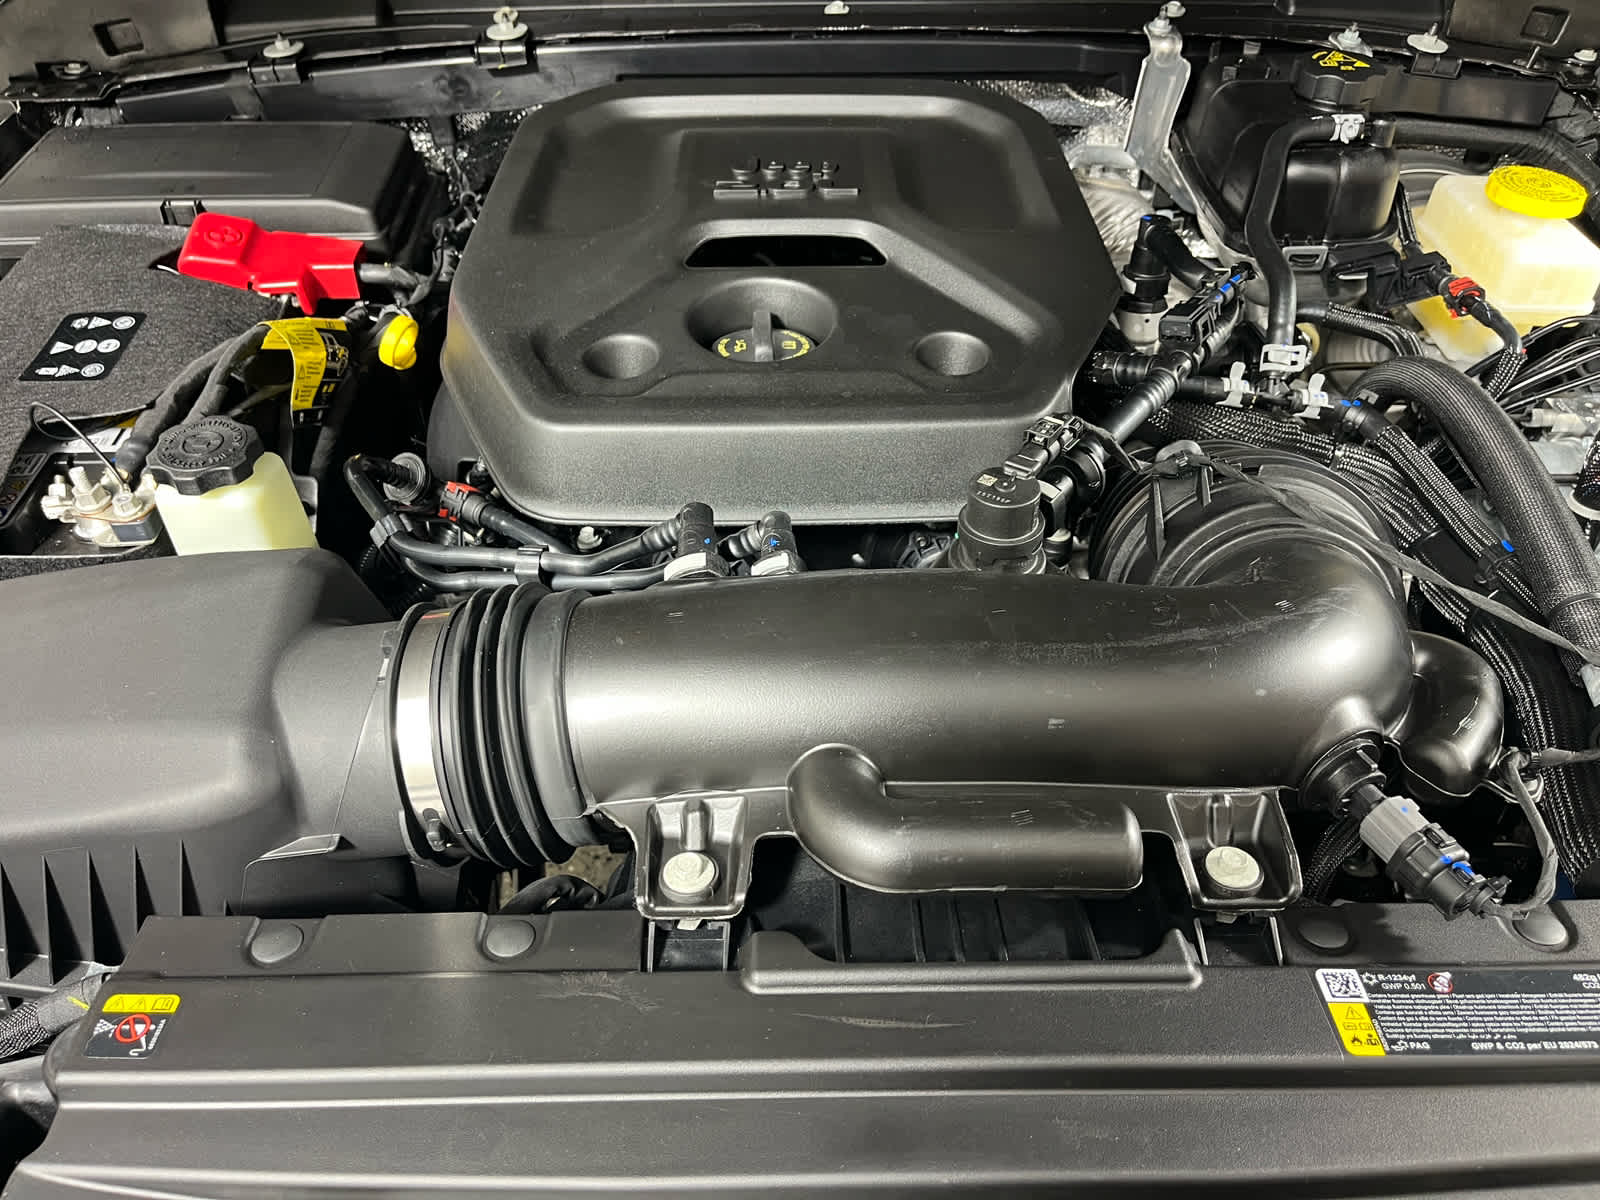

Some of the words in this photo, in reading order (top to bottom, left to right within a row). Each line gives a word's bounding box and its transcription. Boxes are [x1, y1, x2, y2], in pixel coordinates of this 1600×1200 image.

[1381, 982, 1402, 990] GWP
[1408, 1041, 1431, 1050] PAG
[1471, 1042, 1494, 1050] GWP
[1495, 1042, 1504, 1050] &
[1504, 1041, 1526, 1050] CO2
[1542, 1041, 1557, 1049] EU
